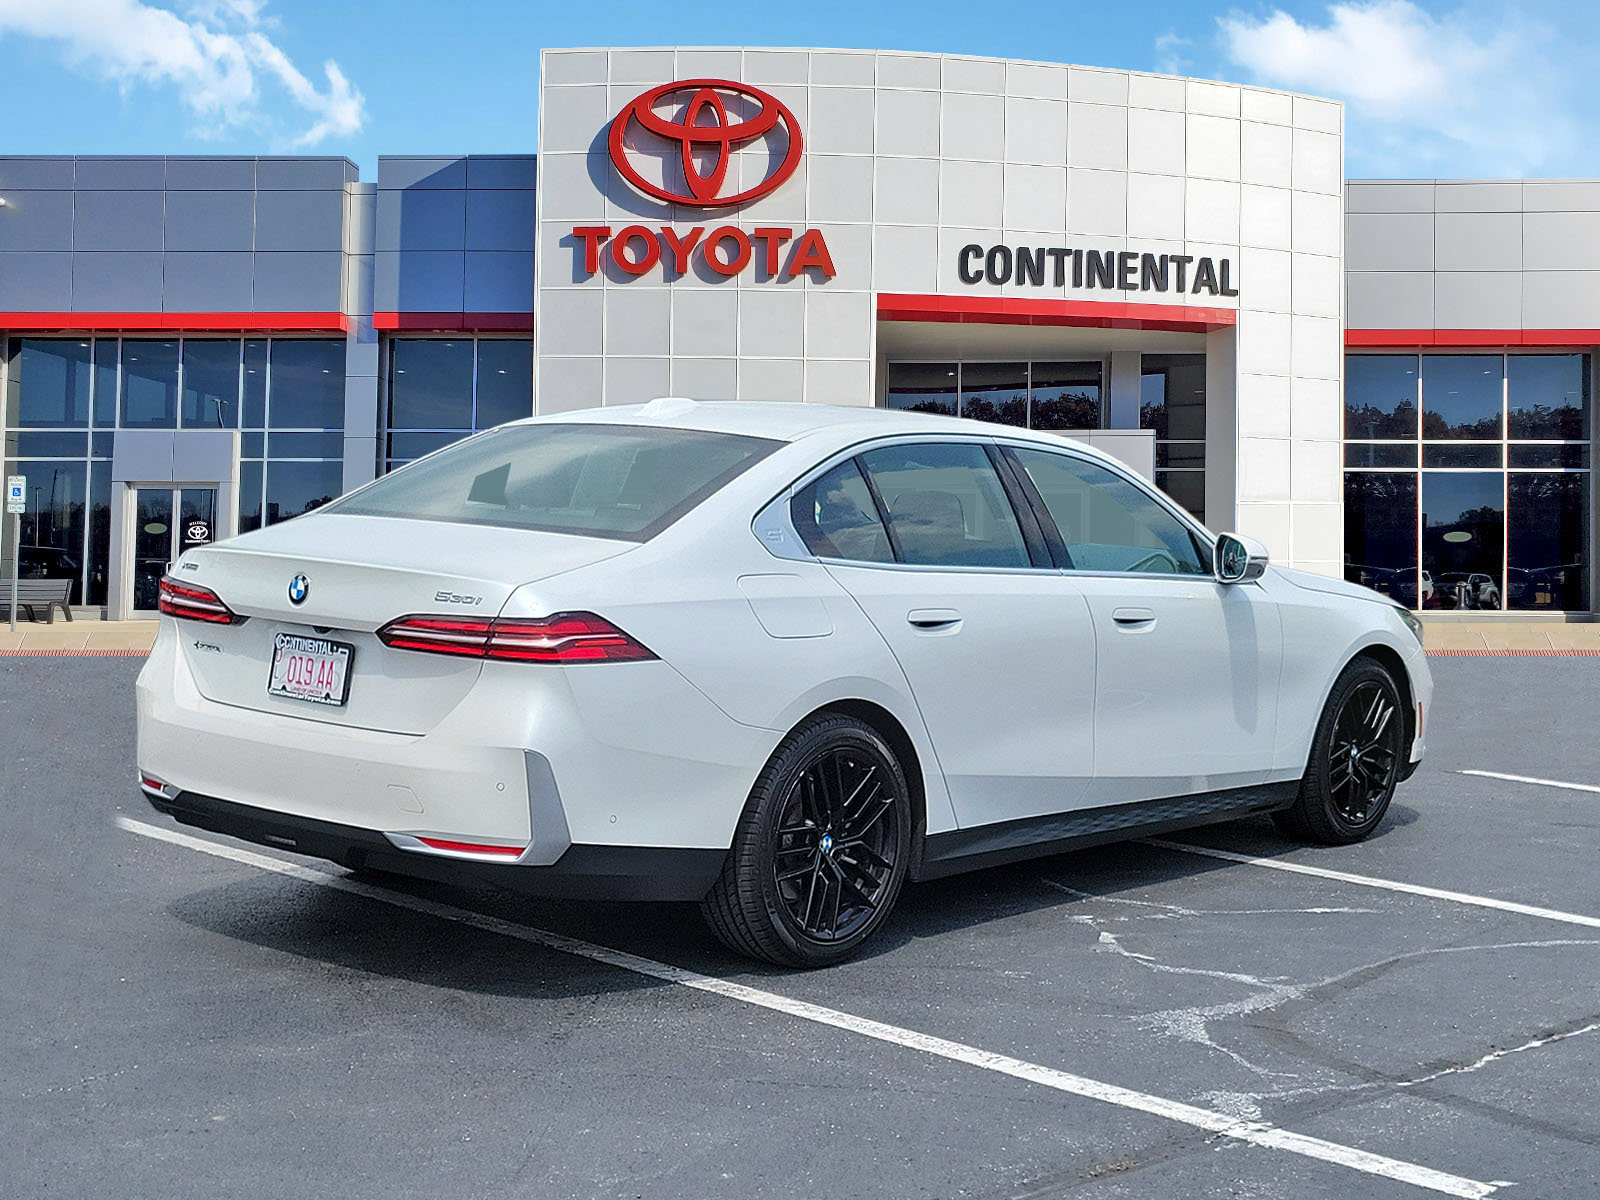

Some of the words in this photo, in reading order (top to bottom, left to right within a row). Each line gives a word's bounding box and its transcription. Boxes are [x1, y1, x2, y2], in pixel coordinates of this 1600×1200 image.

[572, 225, 836, 277] TOYOTA
[958, 244, 1239, 297] CONTINENTAL
[434, 590, 483, 606] 530i
[275, 634, 333, 655] CONTINENTAL
[317, 659, 335, 690] AA
